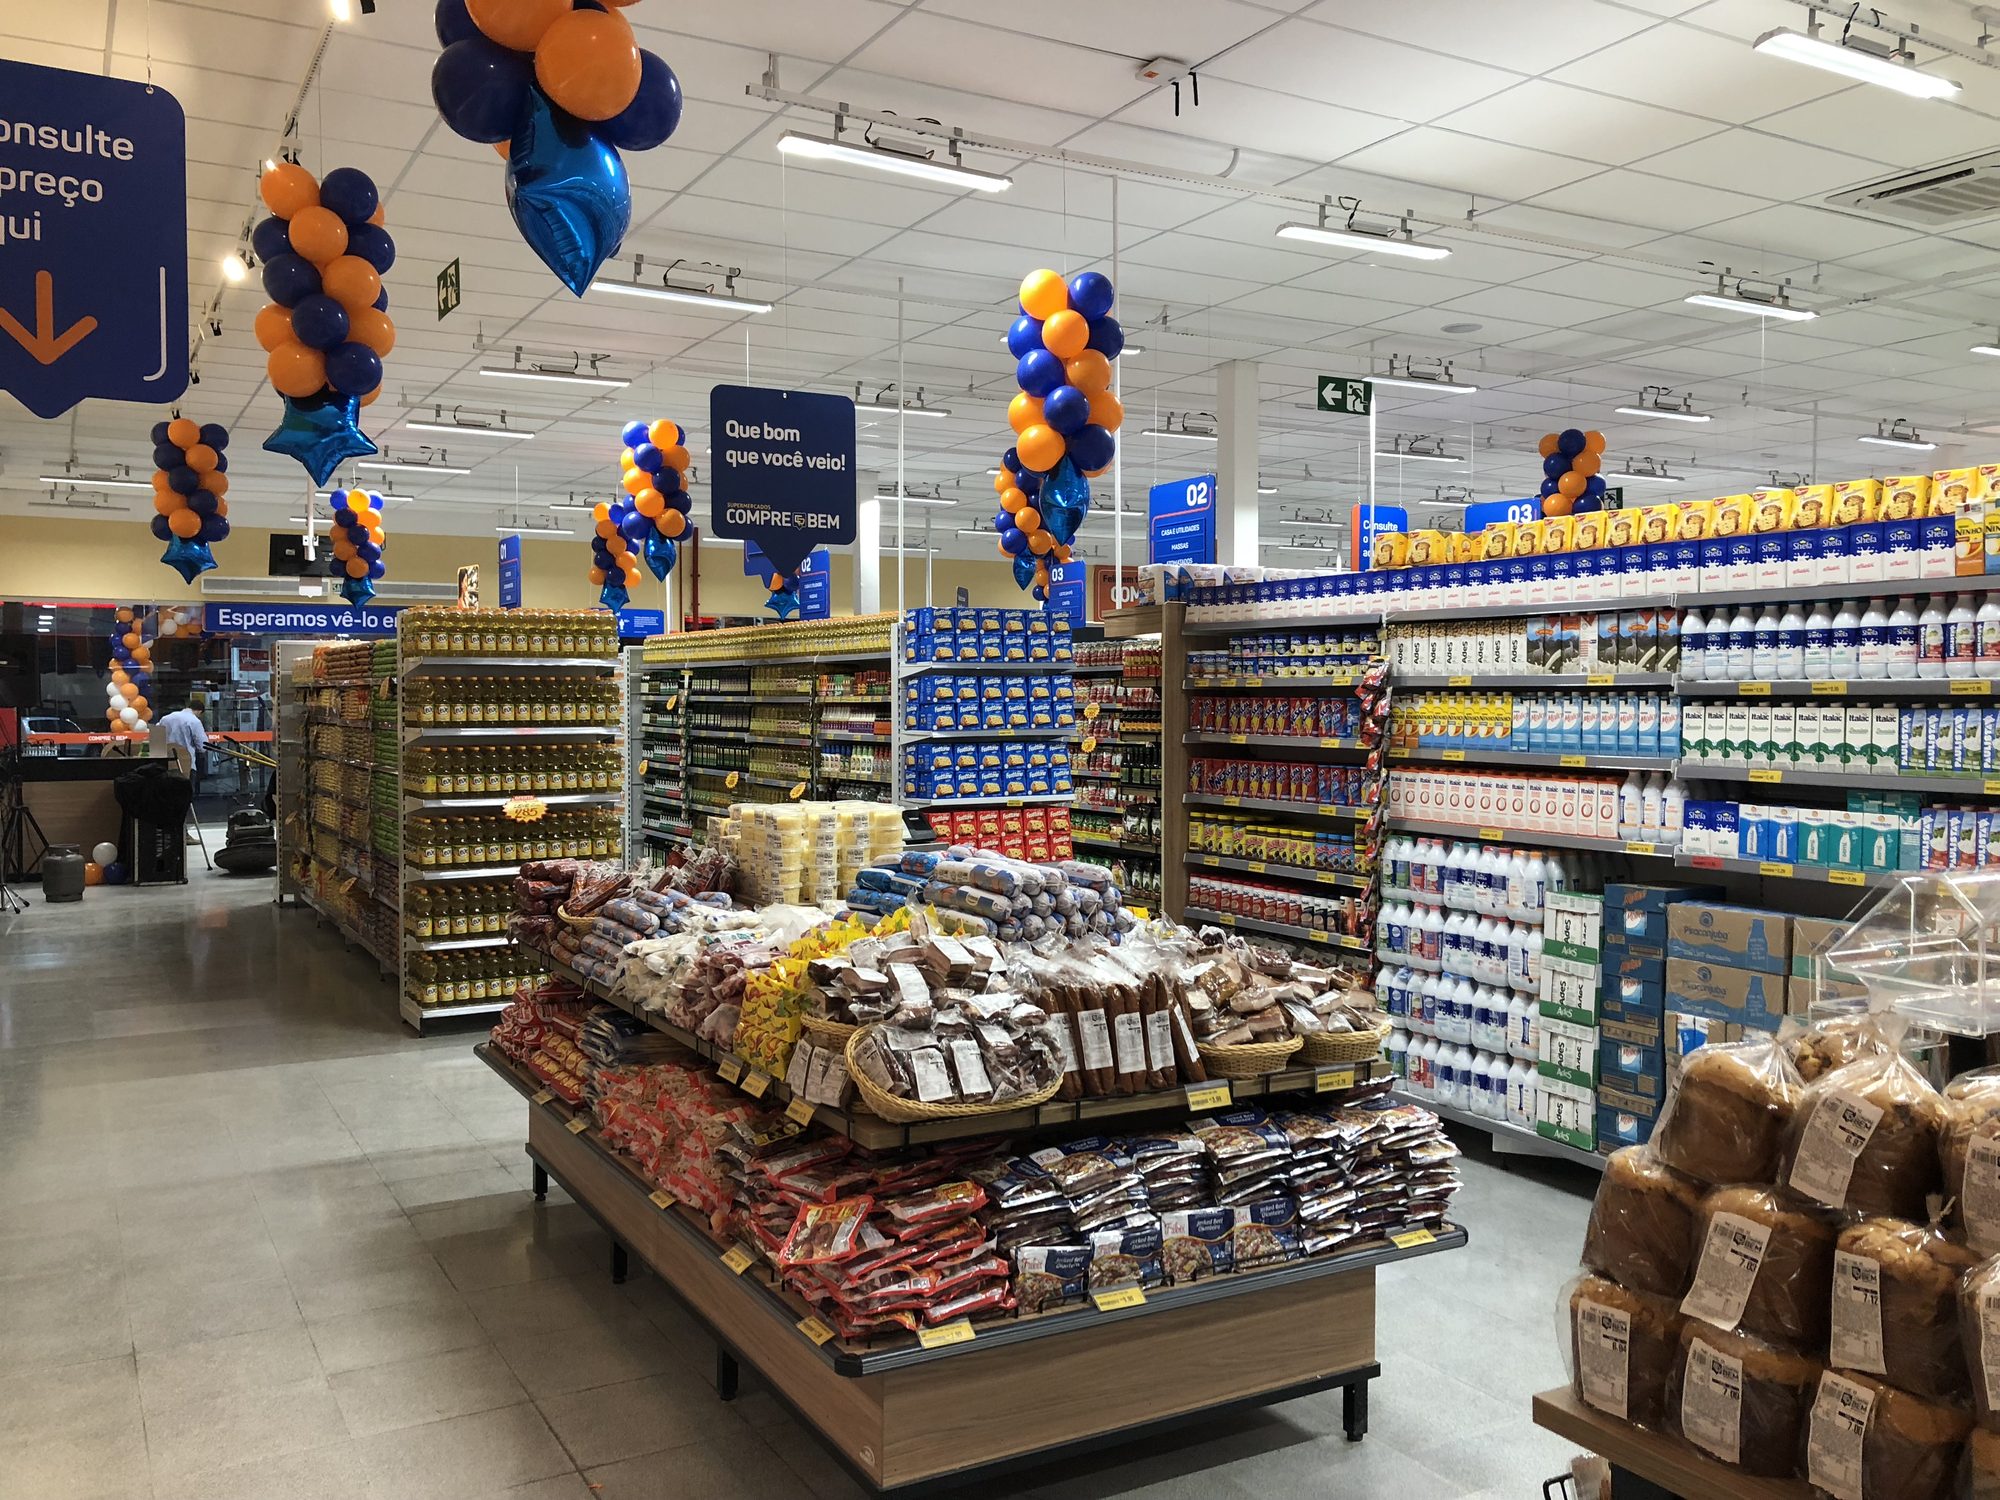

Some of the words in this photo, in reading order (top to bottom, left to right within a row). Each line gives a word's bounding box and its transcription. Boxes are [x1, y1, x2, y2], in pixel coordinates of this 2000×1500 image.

[0, 166, 103, 208] preço
[0, 211, 41, 245] ui
[725, 419, 760, 440] Que
[763, 422, 800, 442] bom
[725, 449, 759, 468] que
[761, 450, 803, 467] você
[806, 453, 846, 471] veio!
[1186, 482, 1208, 507] 02
[727, 502, 771, 510] SUPERMERCADOS
[726, 508, 792, 527] COMPRE
[807, 513, 840, 530] BEM
[1507, 504, 1533, 524] 03
[1161, 528, 1173, 537] CASA
[1176, 524, 1200, 534] UTILIDADES
[1363, 519, 1399, 532] Cnsulte
[1956, 527, 1982, 536] NINHO
[500, 543, 507, 560] 01
[1171, 542, 1189, 551] MASSAS
[801, 557, 811, 573] 02
[1051, 567, 1064, 582] 03
[218, 608, 328, 630] Esperamos
[331, 610, 379, 628] vê-lo
[383, 615, 397, 629] e
[1685, 711, 1702, 719] Italac
[1729, 712, 1746, 720] Italac
[1751, 712, 1769, 720] Italac
[1774, 713, 1792, 721] Italac
[1798, 714, 1817, 722] Italac
[1822, 714, 1842, 722] Italac
[1849, 714, 1869, 722] Italac
[1875, 715, 1896, 723] Italac
[1901, 714, 1911, 766] PAULISTA
[1927, 714, 1937, 767] PAULISTA
[1954, 714, 1965, 768] PAULISTA
[1983, 714, 1994, 768] PAULISTA
[1863, 1293, 1879, 1305] 7.12
